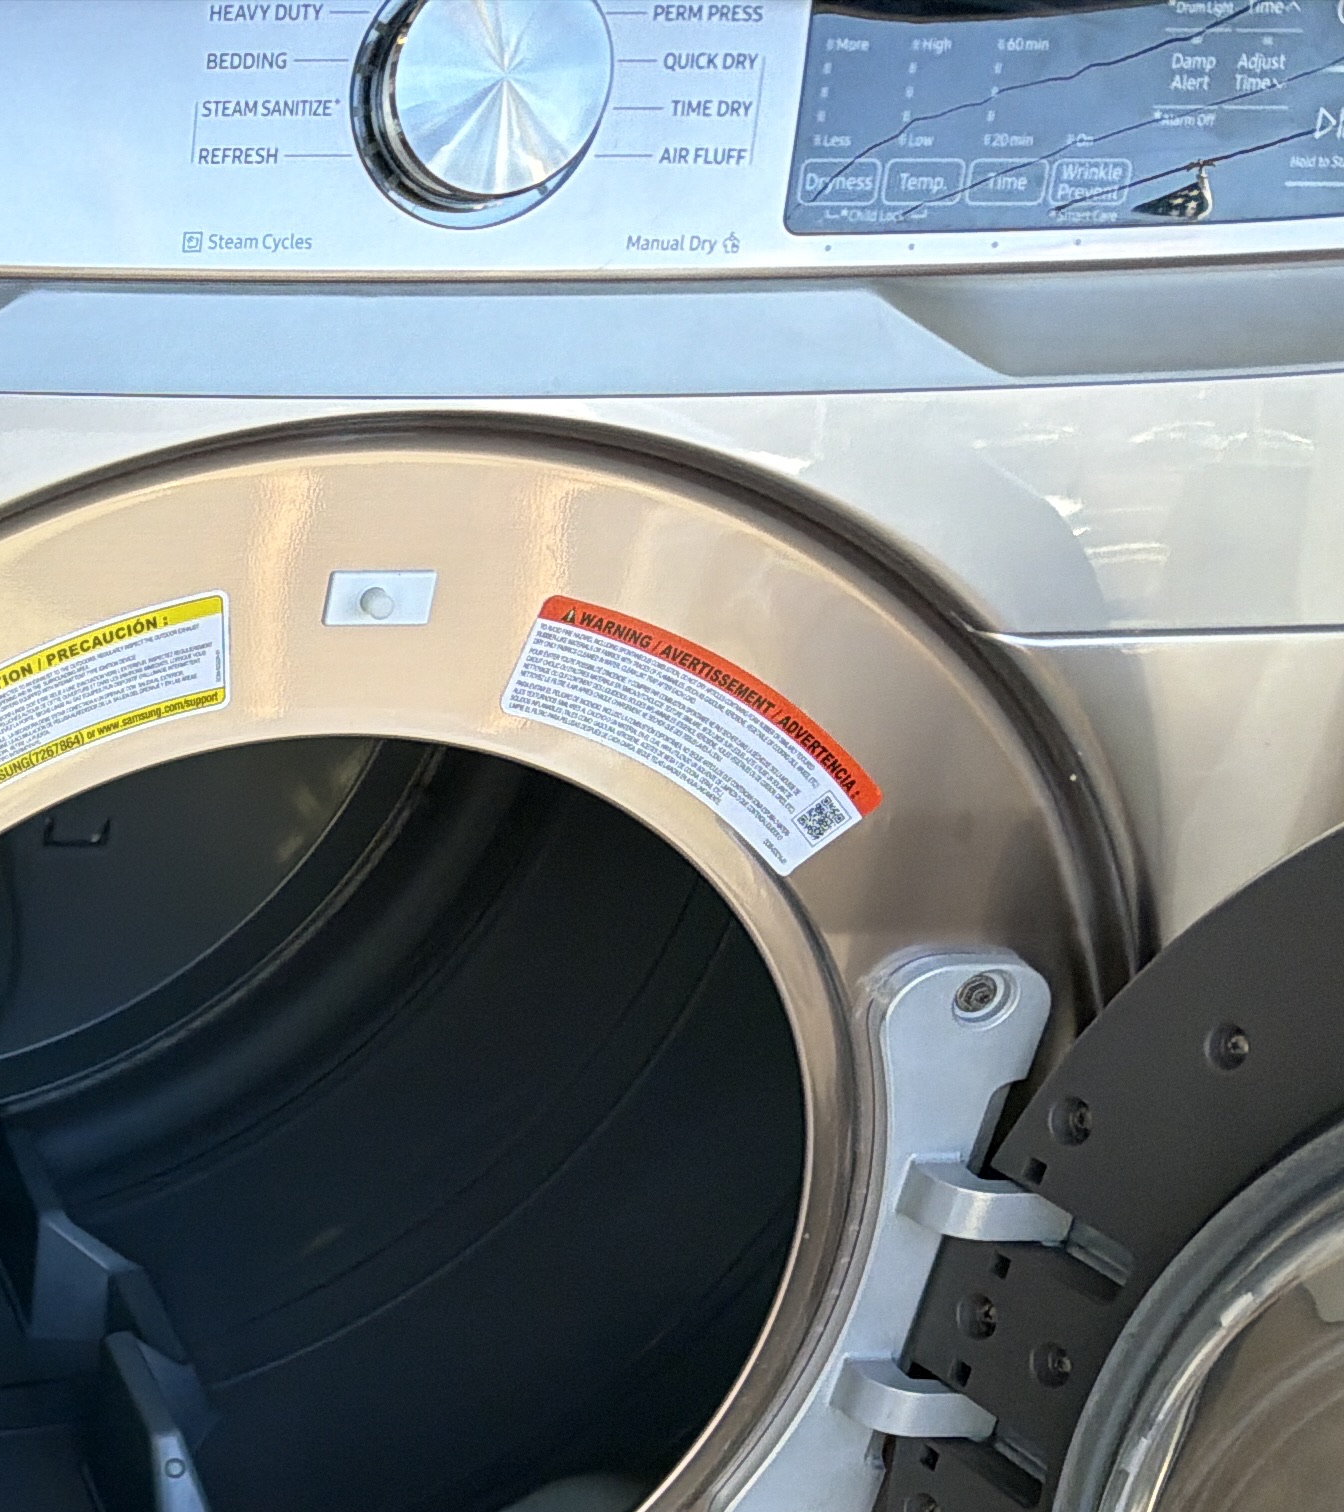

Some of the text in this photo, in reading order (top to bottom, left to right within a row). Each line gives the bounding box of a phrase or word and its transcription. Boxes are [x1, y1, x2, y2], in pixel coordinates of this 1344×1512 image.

[209, 4, 324, 21] HEAVY DUTY
[653, 4, 763, 23] PERM PRESS
[206, 52, 288, 70] BEDDING
[663, 52, 758, 71] QUICK DRY
[1171, 52, 1216, 72] Damp
[1236, 53, 1286, 71] Adjust
[1169, 74, 1210, 91] Alert
[1235, 75, 1272, 91] Time
[201, 100, 258, 117] STEAM
[671, 100, 753, 117] TIME DRY
[198, 148, 279, 165] REFRESH
[659, 148, 748, 165] AIR FLUFF
[1062, 163, 1123, 181] Wrinkle
[805, 173, 874, 195] Dryness
[899, 173, 947, 194] Temp.
[986, 175, 1027, 191] Time
[1057, 184, 1119, 200] Prevent
[207, 233, 313, 252] Steam Cycles
[626, 235, 716, 255] Manual Dry
[47, 614, 158, 666] PRECAUCIÓN
[579, 612, 653, 649] WARNING
[661, 644, 774, 721] AVERTISSEMENT
[779, 715, 856, 792] ADVERTENCIA
[87, 729, 96, 740] or
[97, 692, 219, 736] www.samsung.com/support
